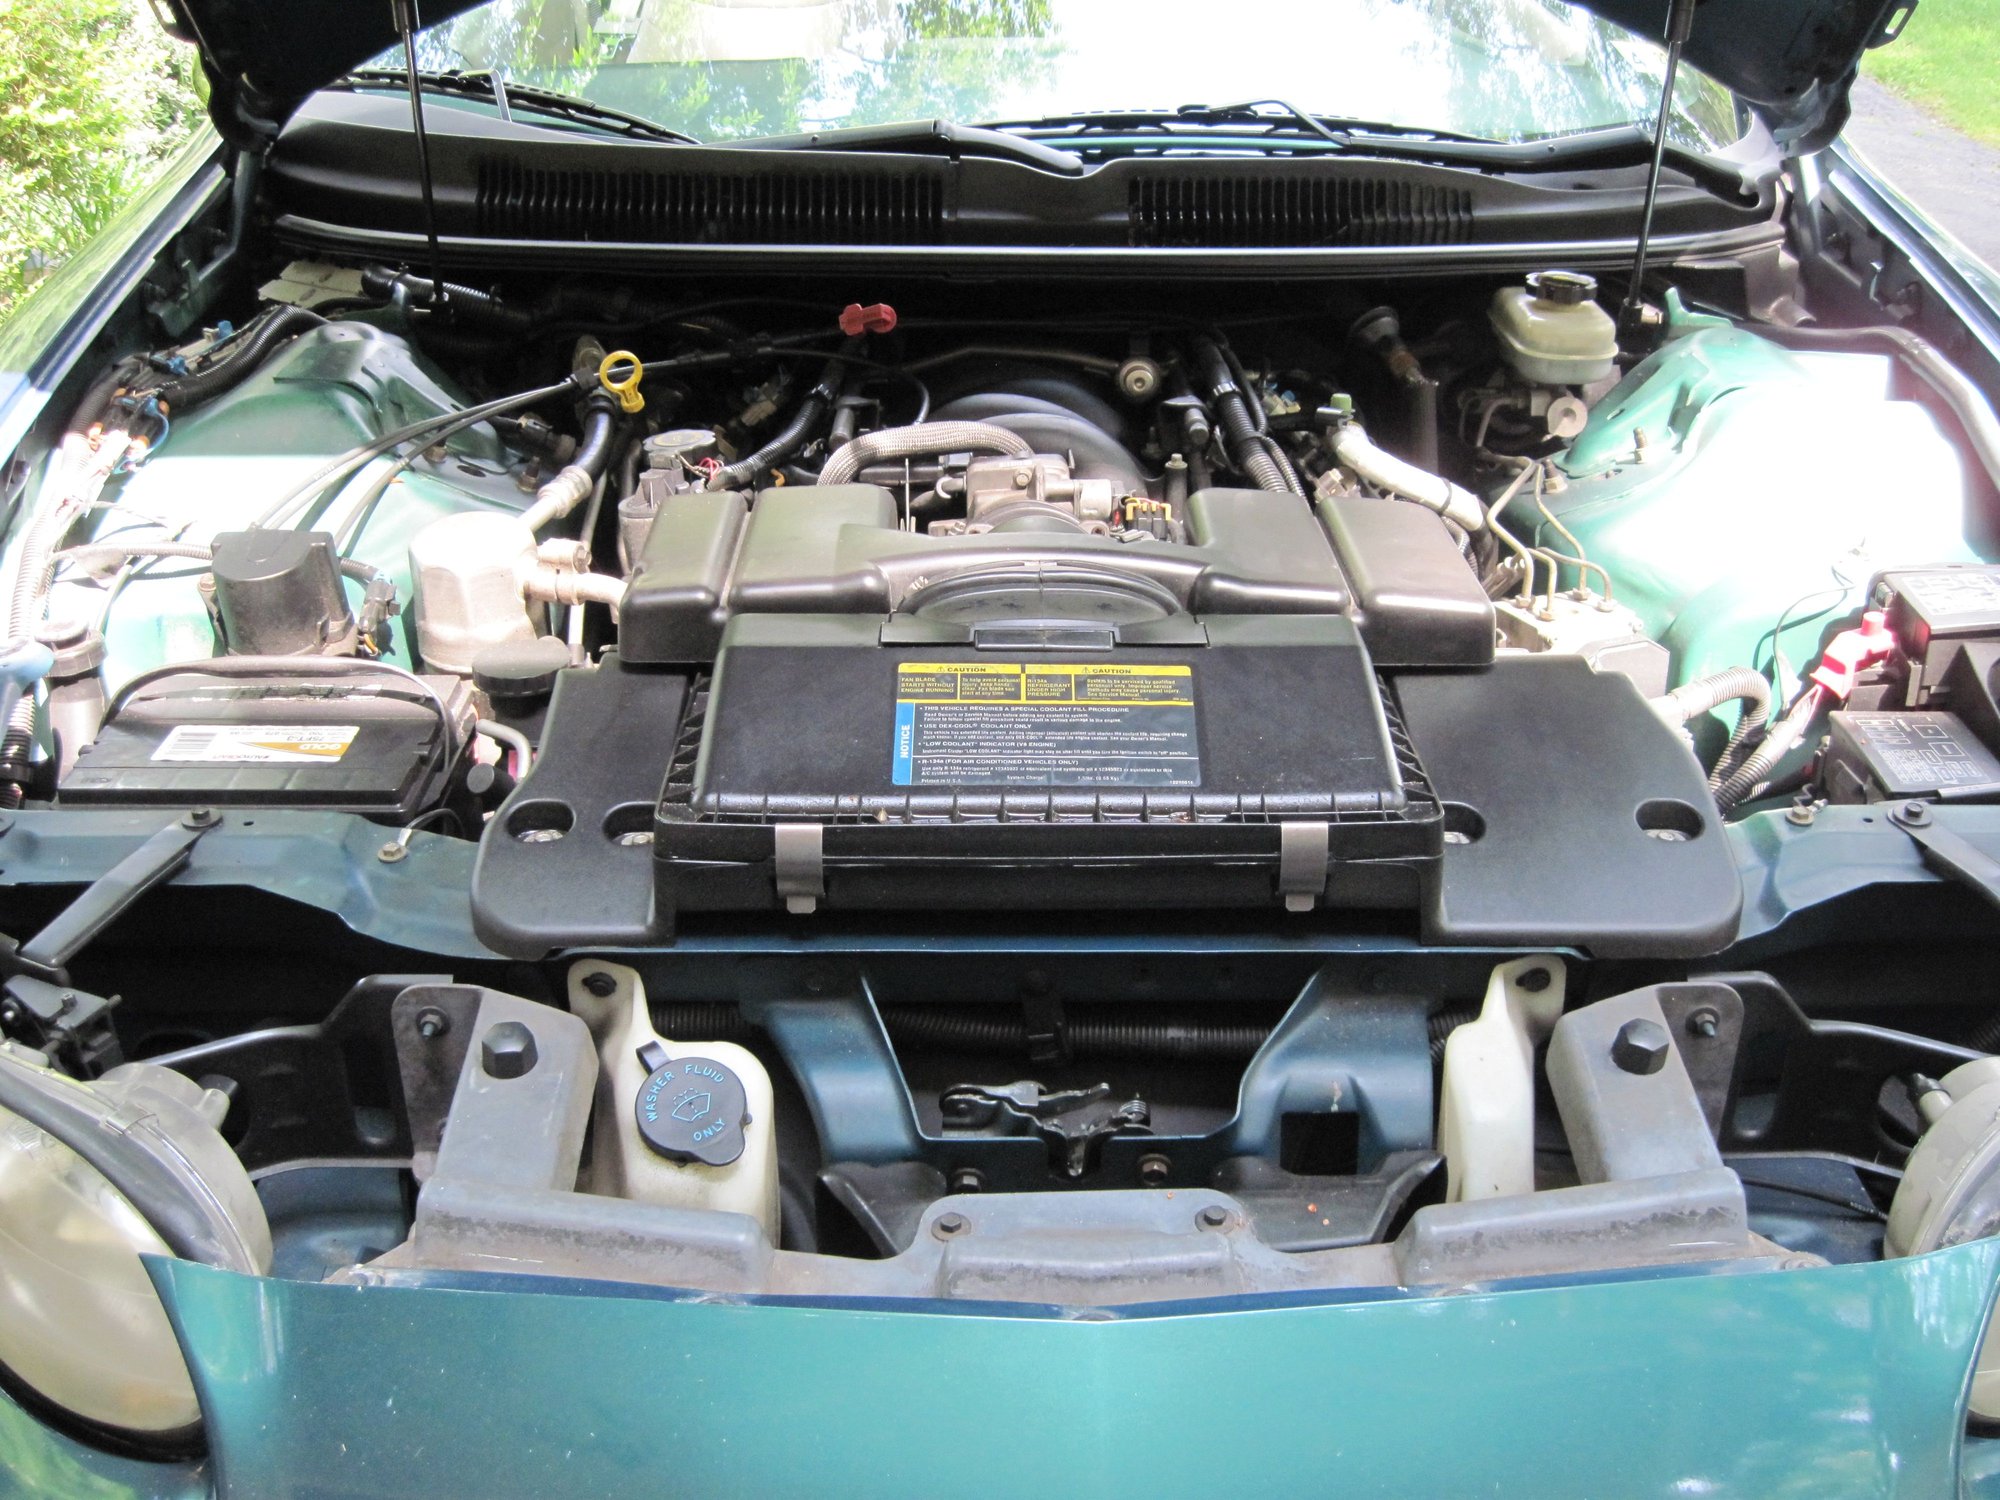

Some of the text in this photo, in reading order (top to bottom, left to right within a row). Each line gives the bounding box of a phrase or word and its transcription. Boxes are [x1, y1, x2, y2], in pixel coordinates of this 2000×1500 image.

[900, 724, 911, 758] NOTICE
[645, 1064, 725, 1122] WASHER FLUID
[693, 1117, 725, 1141] ONLY
